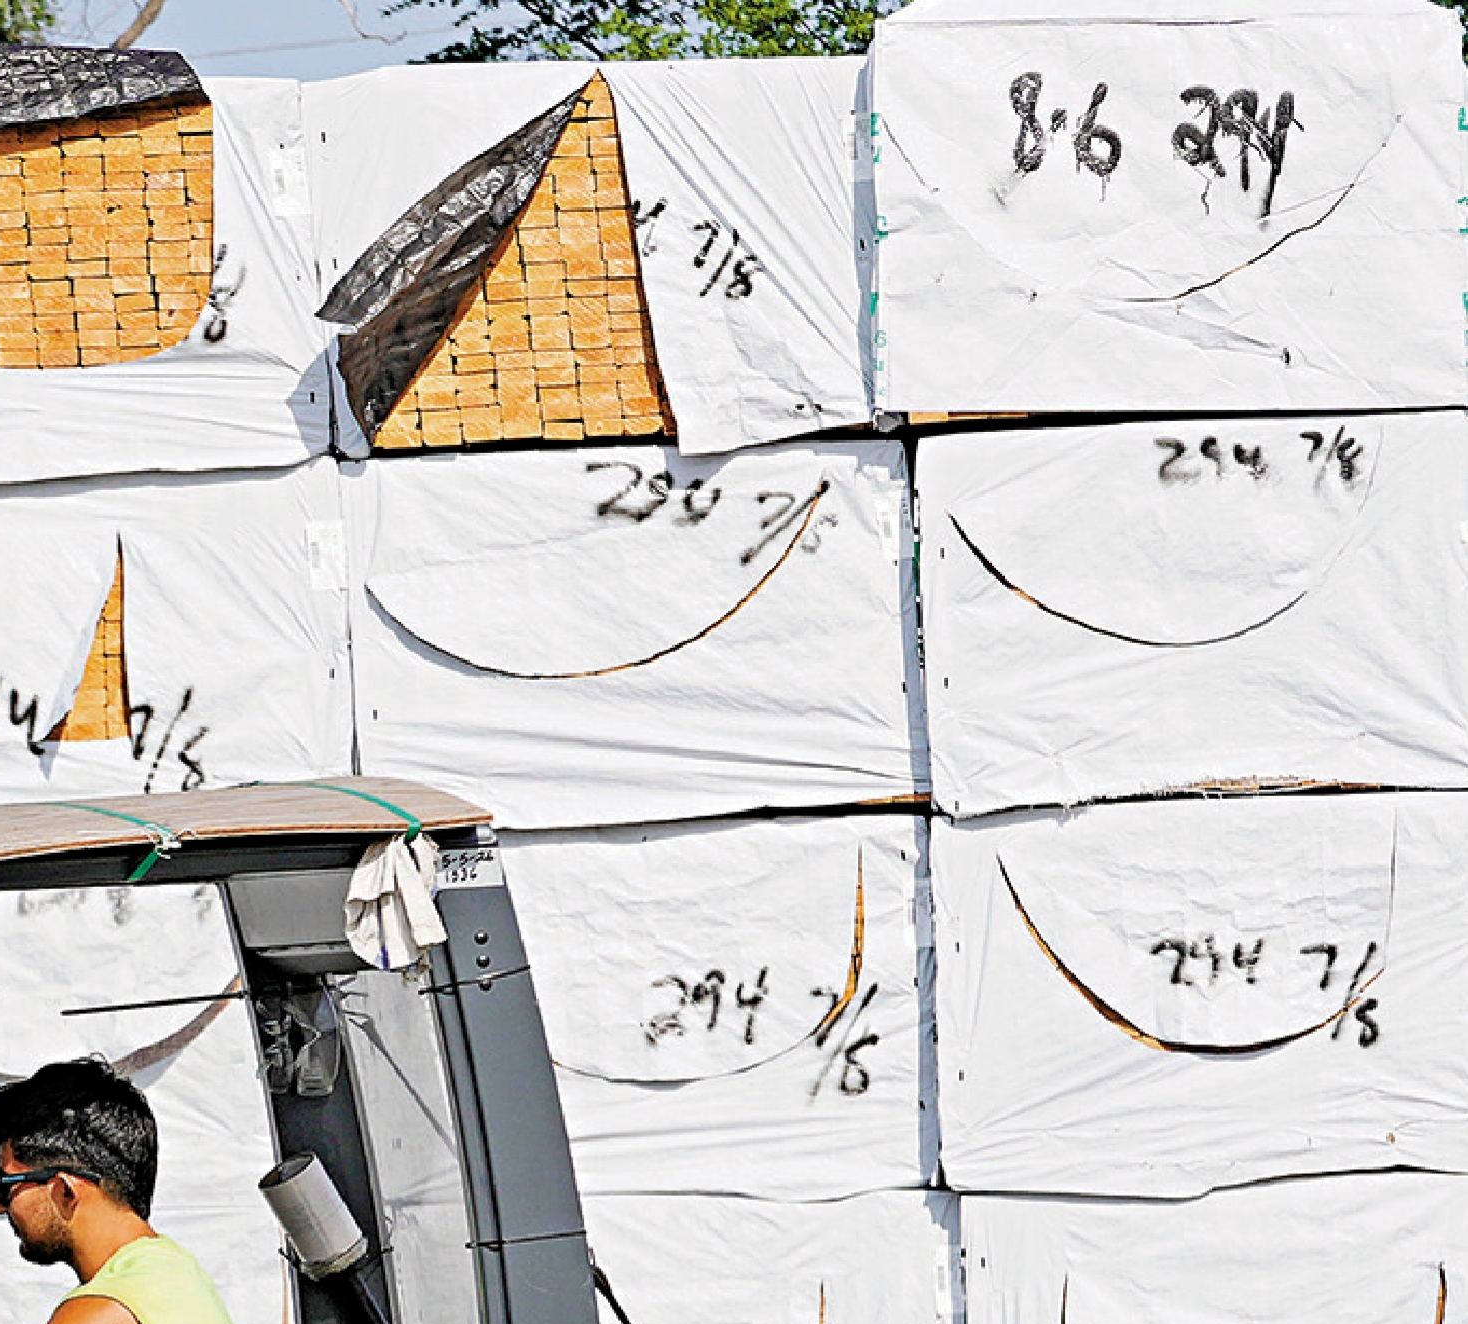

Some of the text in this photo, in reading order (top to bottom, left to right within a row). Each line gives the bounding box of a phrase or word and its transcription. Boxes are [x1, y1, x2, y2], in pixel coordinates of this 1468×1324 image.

[1172, 86, 1303, 230] 294
[693, 219, 767, 299] 7/8
[1151, 434, 1268, 484] 294
[1300, 940, 1381, 1048] 7/8
